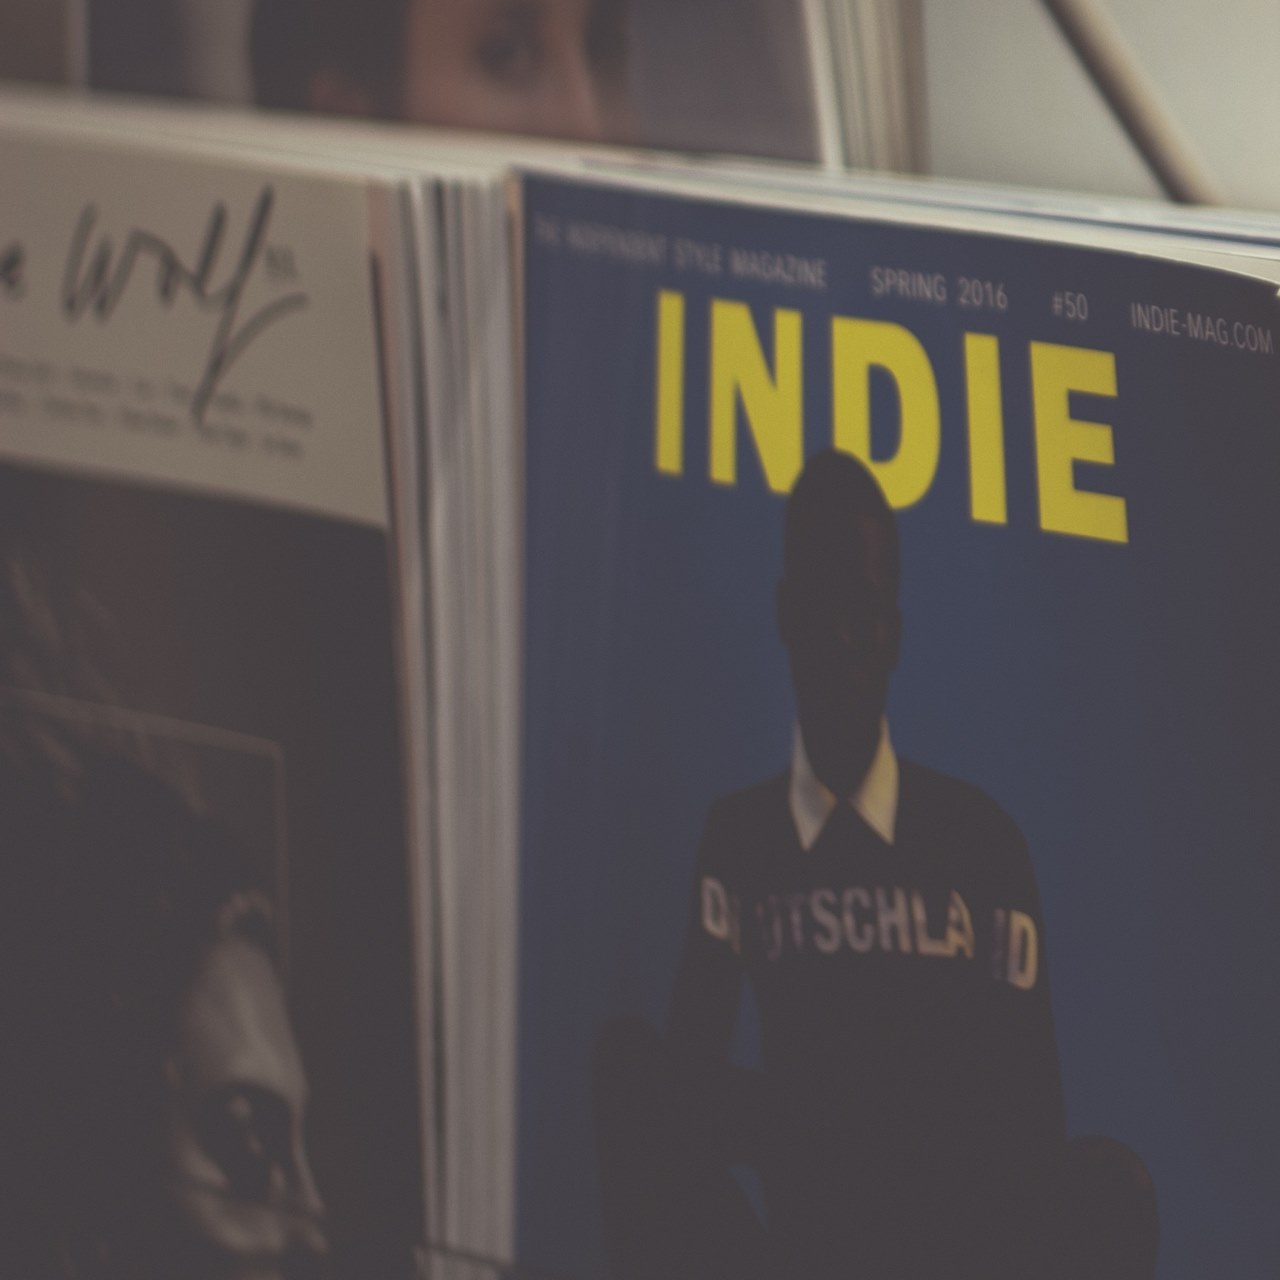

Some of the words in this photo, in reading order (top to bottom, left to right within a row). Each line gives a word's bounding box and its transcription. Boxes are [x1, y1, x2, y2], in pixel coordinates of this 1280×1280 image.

[674, 236, 722, 278] STYLE
[730, 248, 828, 292] MAGAZINE
[871, 266, 948, 306] SPRING
[958, 276, 1008, 311] 2016
[1052, 289, 1089, 321] #50
[1130, 301, 1276, 356] INDIE-MAG.COM
[654, 287, 1130, 544] INDIE
